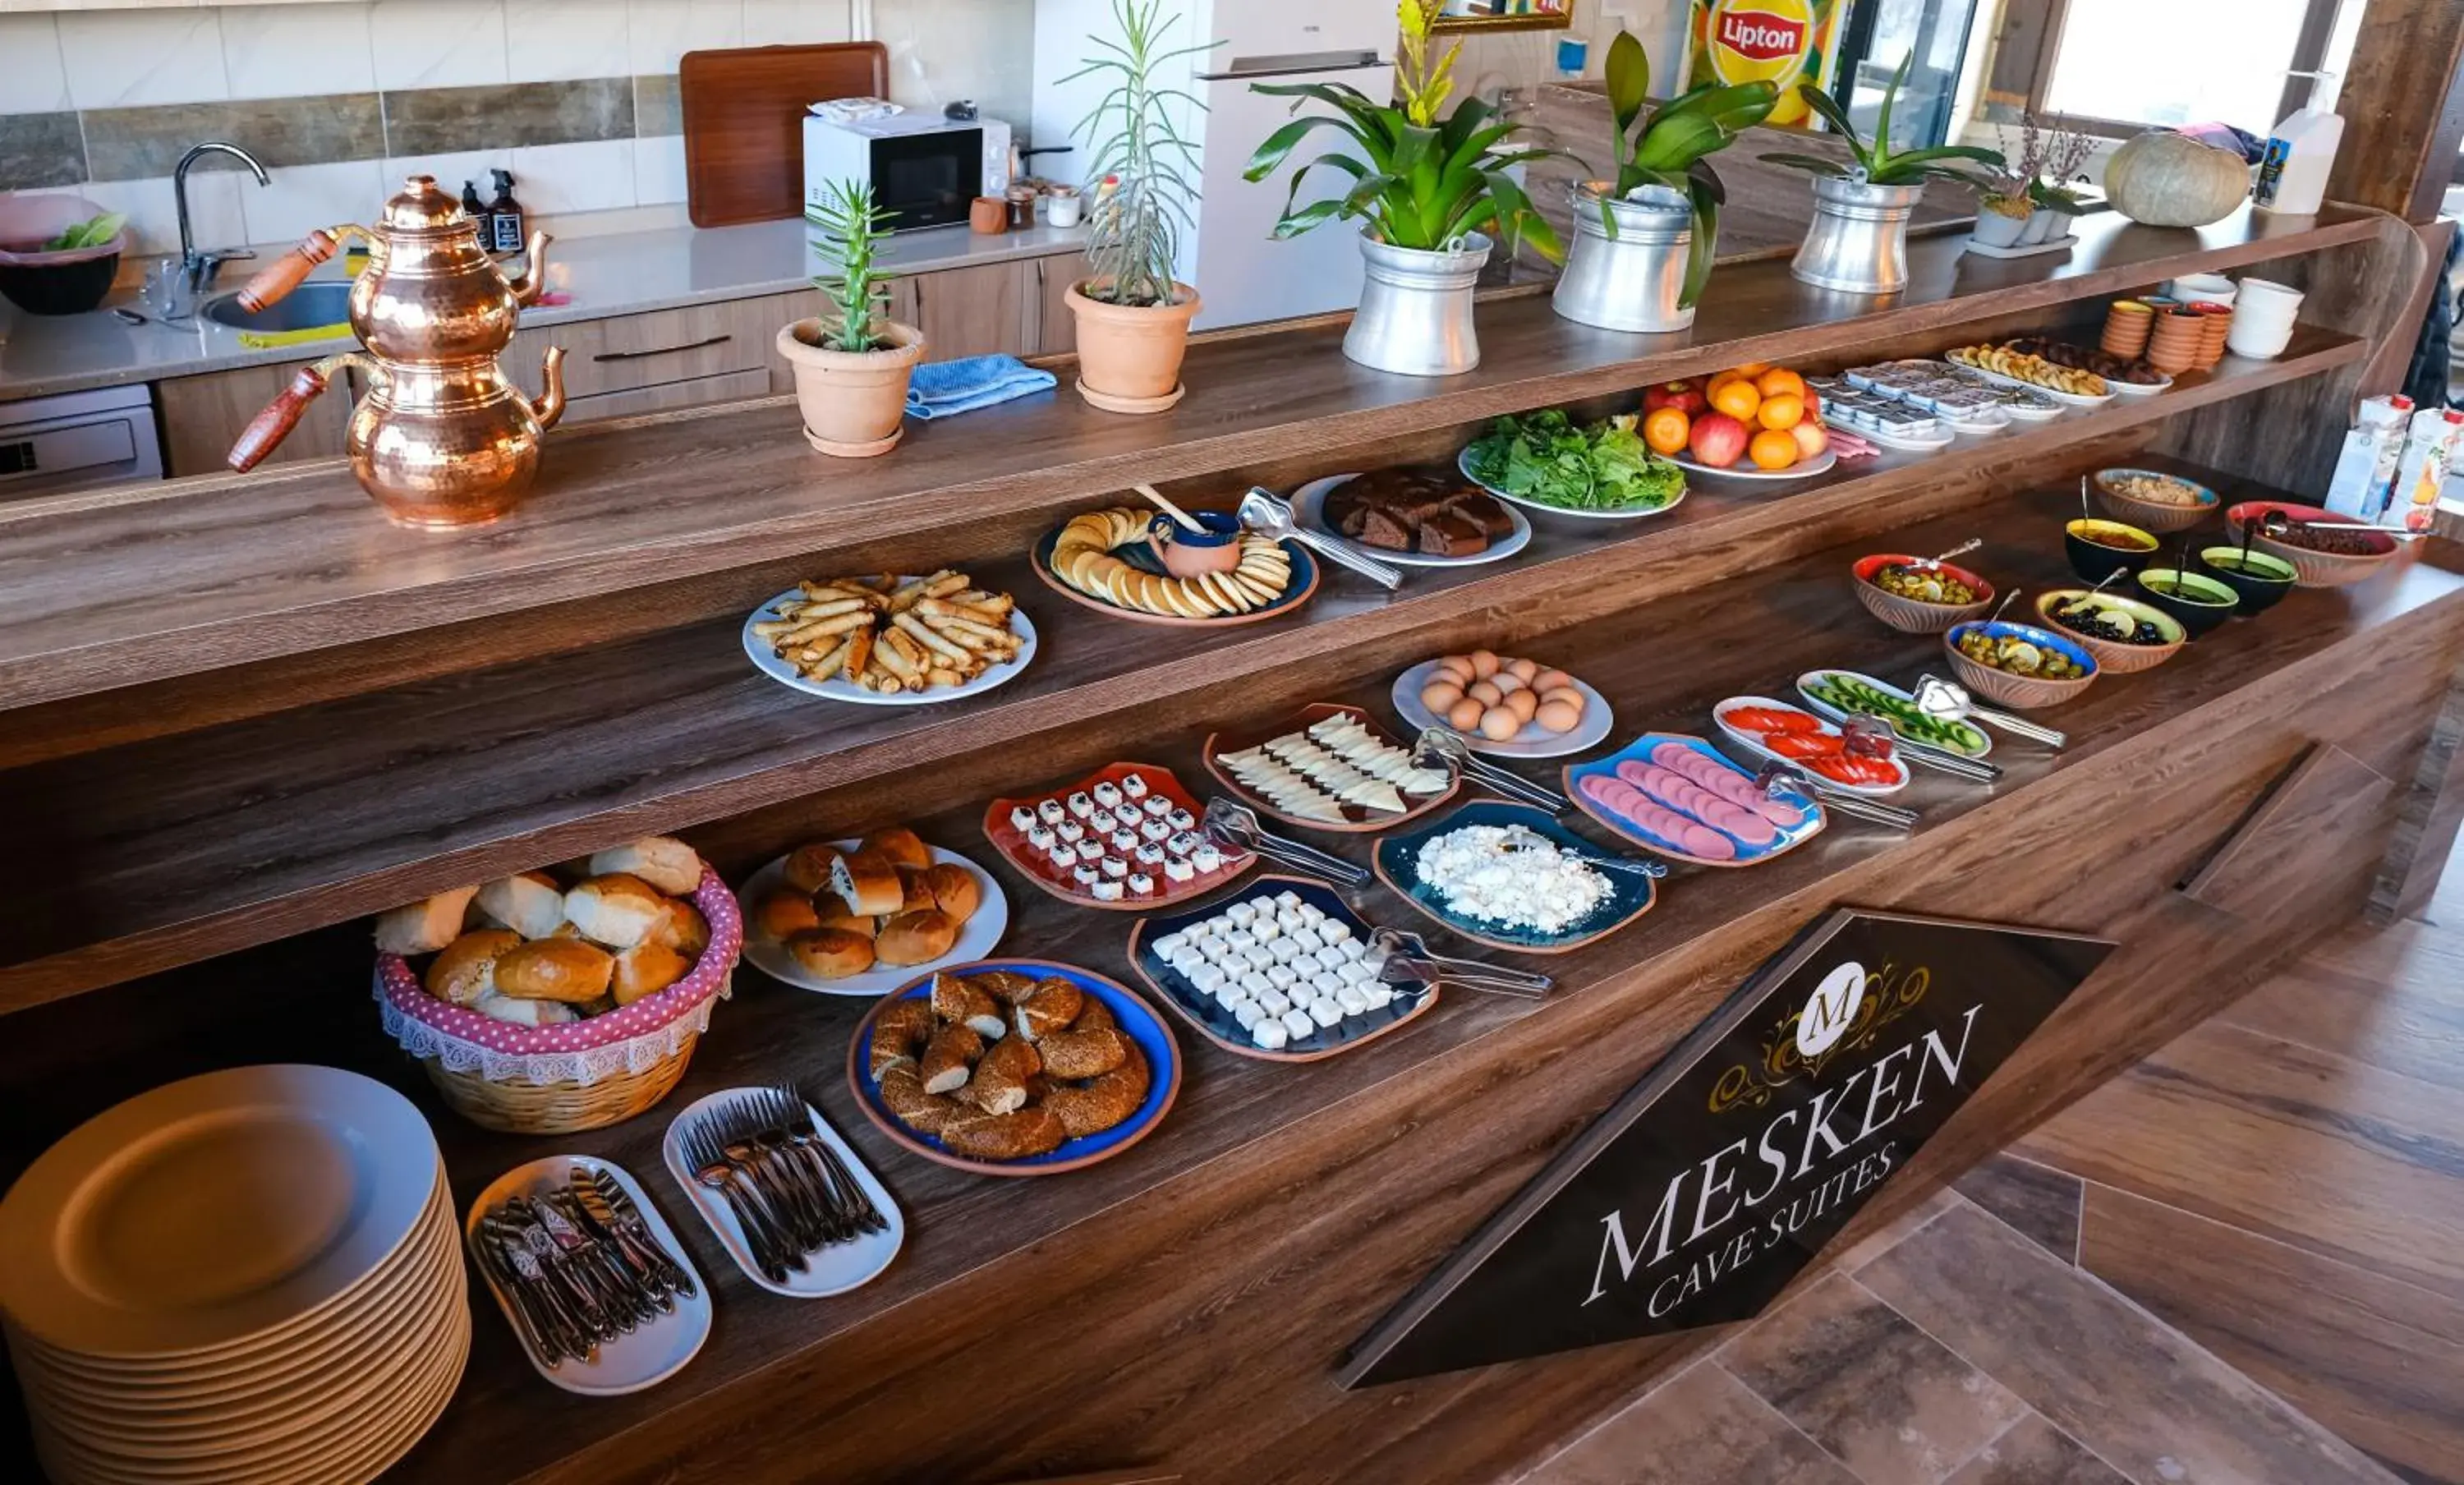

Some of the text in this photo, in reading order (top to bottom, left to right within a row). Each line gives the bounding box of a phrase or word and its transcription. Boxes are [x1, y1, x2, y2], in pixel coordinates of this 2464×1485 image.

[1724, 17, 1796, 50] Lipton
[1805, 976, 1859, 1042] M
[1580, 1004, 1984, 1307] MESKEN
[1648, 1141, 1896, 1318] CAVE SUITES
